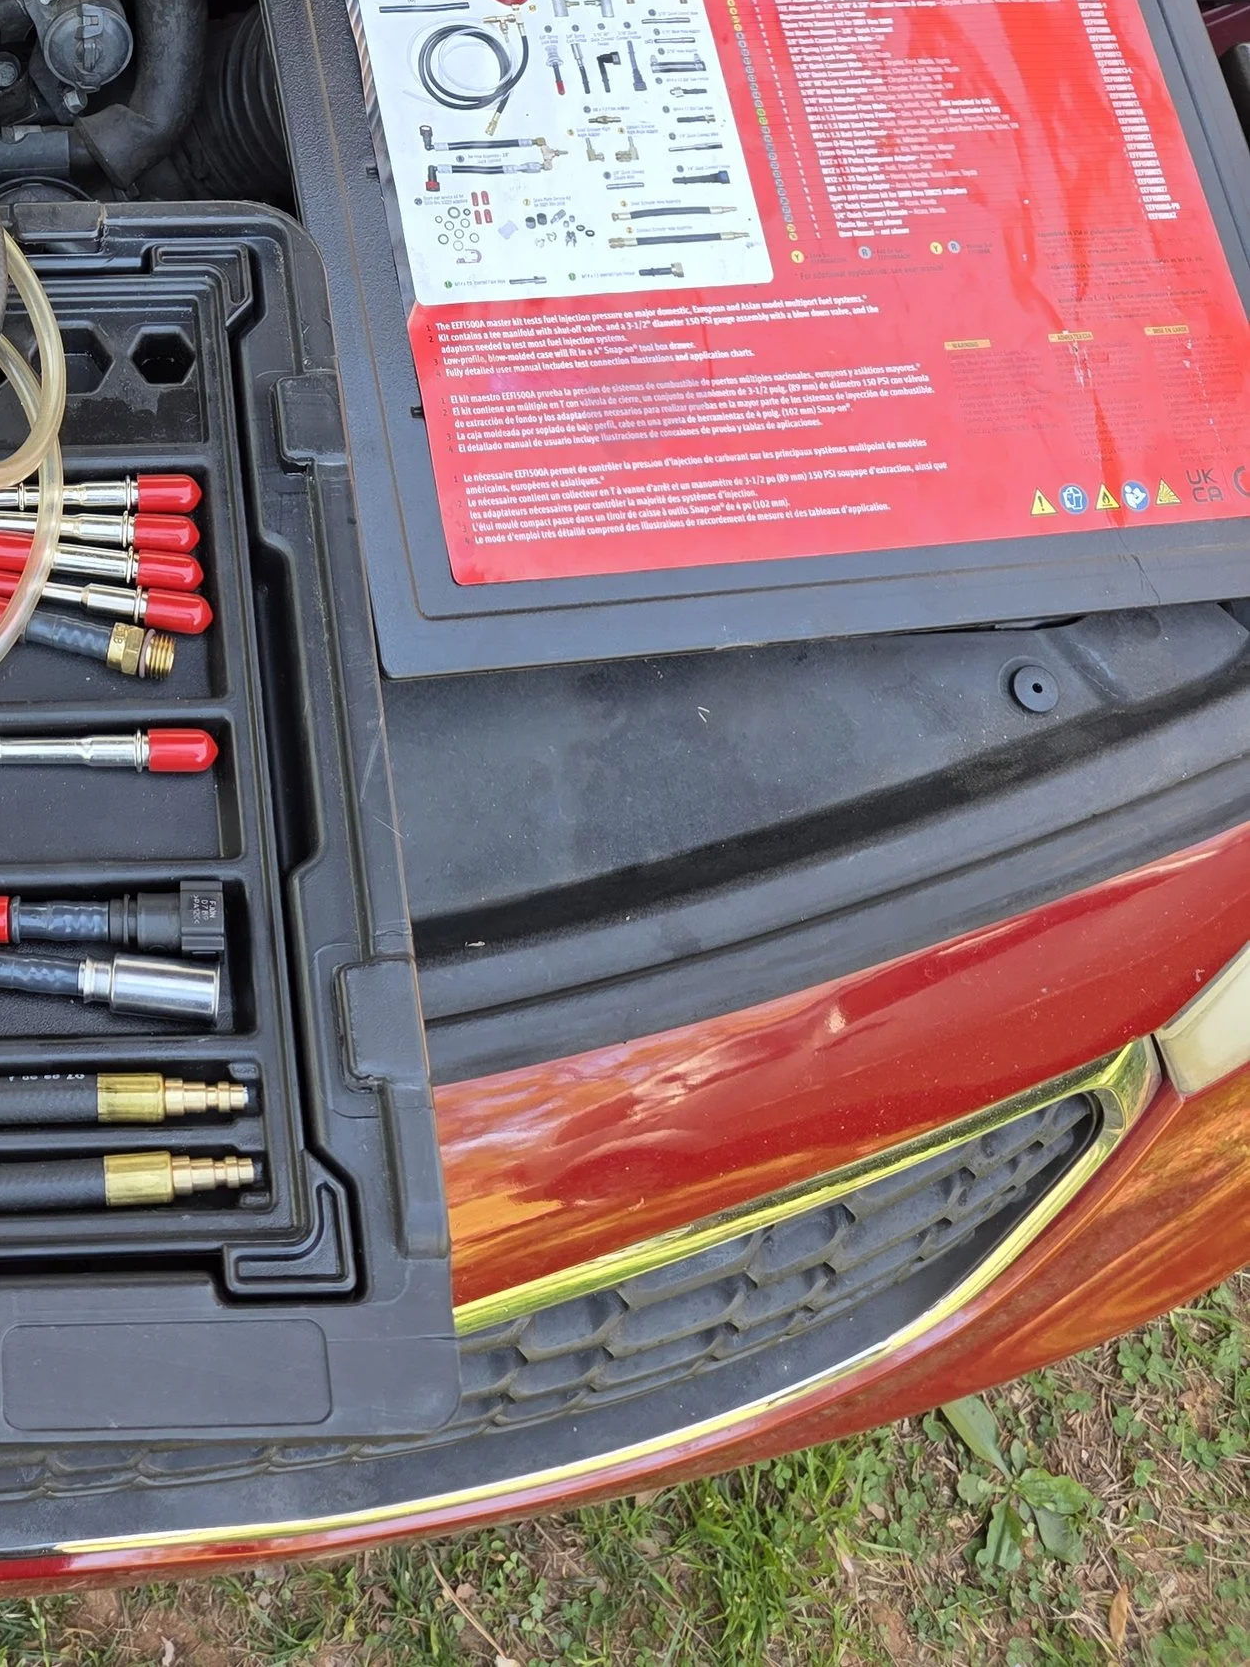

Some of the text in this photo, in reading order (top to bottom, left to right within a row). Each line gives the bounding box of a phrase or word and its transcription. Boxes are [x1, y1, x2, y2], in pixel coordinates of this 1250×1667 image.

[434, 322, 451, 332] The
[485, 318, 512, 328] master
[511, 317, 524, 327] kit
[542, 314, 559, 324] fuel
[557, 313, 592, 325] injection
[590, 311, 624, 323] pressure
[622, 311, 634, 319] on
[633, 308, 657, 319] major
[656, 305, 693, 317] domestic,
[725, 302, 741, 312] and
[740, 301, 762, 311] Asian
[760, 299, 785, 310] model
[817, 296, 834, 306] fuel
[440, 334, 628, 355] adaptors needed to test most fuel injection systems.
[445, 348, 756, 379] Fully detailed user manual includes test connection illustrations and application charts.
[1186, 468, 1214, 485] UK
[1192, 487, 1225, 503] CA
